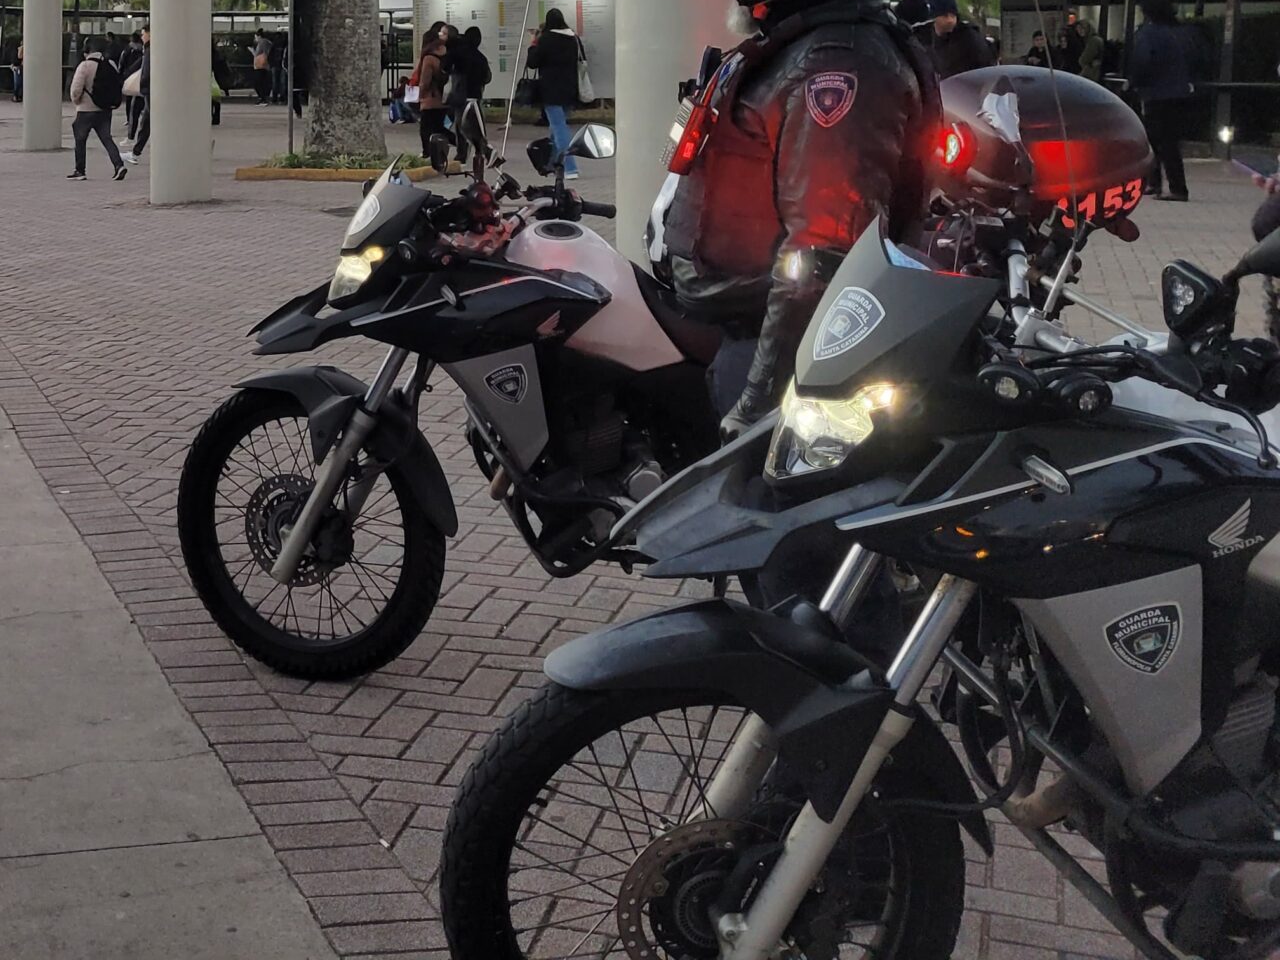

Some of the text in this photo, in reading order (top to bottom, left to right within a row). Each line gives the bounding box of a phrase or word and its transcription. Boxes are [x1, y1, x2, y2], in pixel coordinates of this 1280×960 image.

[847, 292, 873, 312] GUARDA
[840, 326, 869, 349] CATARINA
[820, 345, 840, 356] SANTA
[1212, 535, 1265, 558] HONDA
[1114, 615, 1171, 639] MUNICIPAL
[1118, 609, 1161, 628] GUARDA
